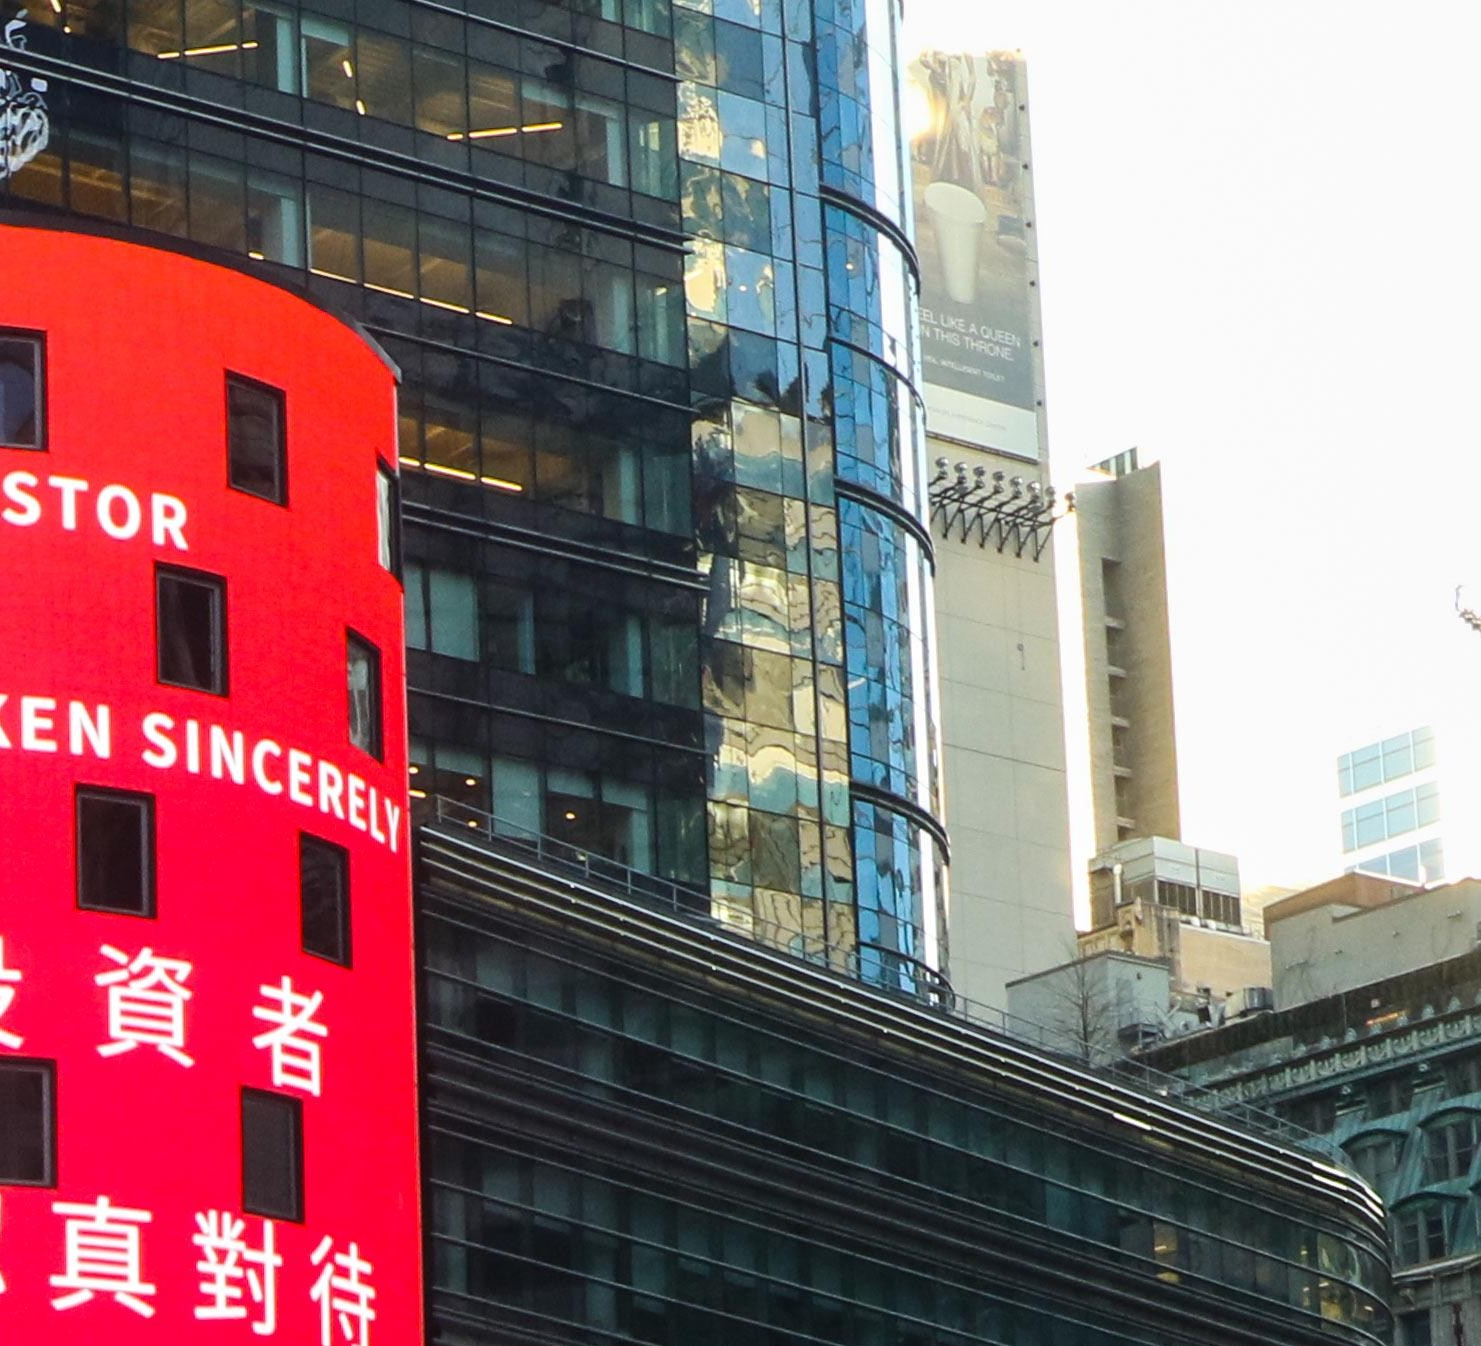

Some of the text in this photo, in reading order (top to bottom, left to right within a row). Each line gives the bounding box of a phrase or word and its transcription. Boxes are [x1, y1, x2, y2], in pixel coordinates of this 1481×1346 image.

[918, 307, 1021, 347] EEL LIKE A QUEEN
[933, 328, 961, 346] THIS
[142, 712, 400, 853] SINCERELY
